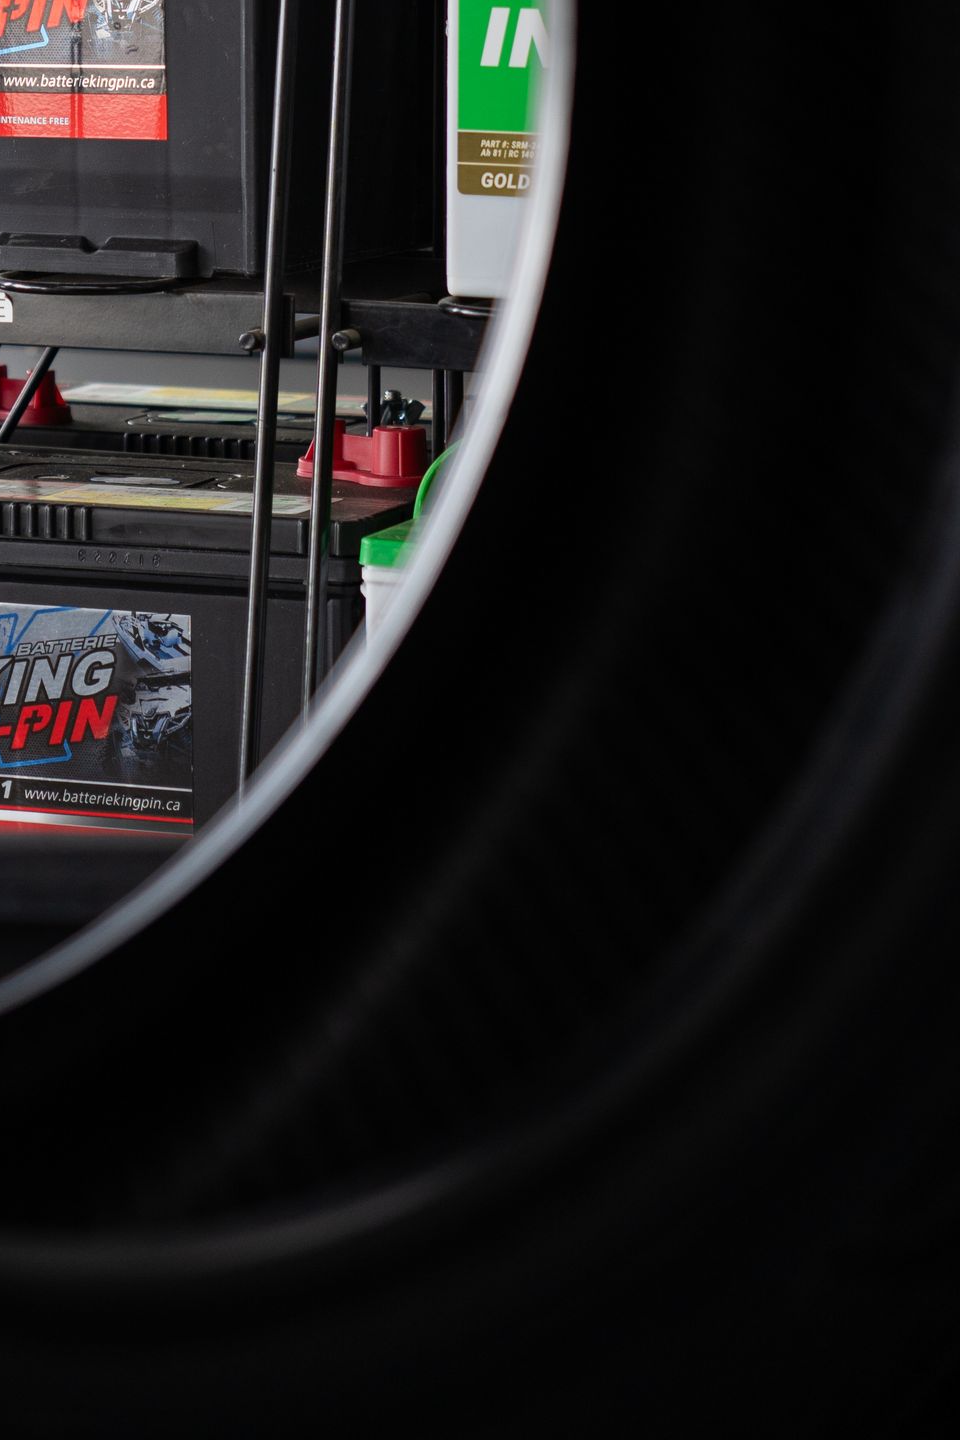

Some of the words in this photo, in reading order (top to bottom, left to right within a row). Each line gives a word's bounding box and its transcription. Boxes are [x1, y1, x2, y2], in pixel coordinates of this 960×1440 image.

[3, 73, 155, 90] www.batteriekingpin.ca
[49, 117, 70, 126] FREE
[480, 140, 501, 148] PART
[480, 149, 491, 157] Ah
[508, 150, 519, 158] RC
[480, 172, 530, 189] GOLD
[16, 633, 119, 658] BATTERIE
[24, 788, 181, 812] www.batteriekingpin.ca
